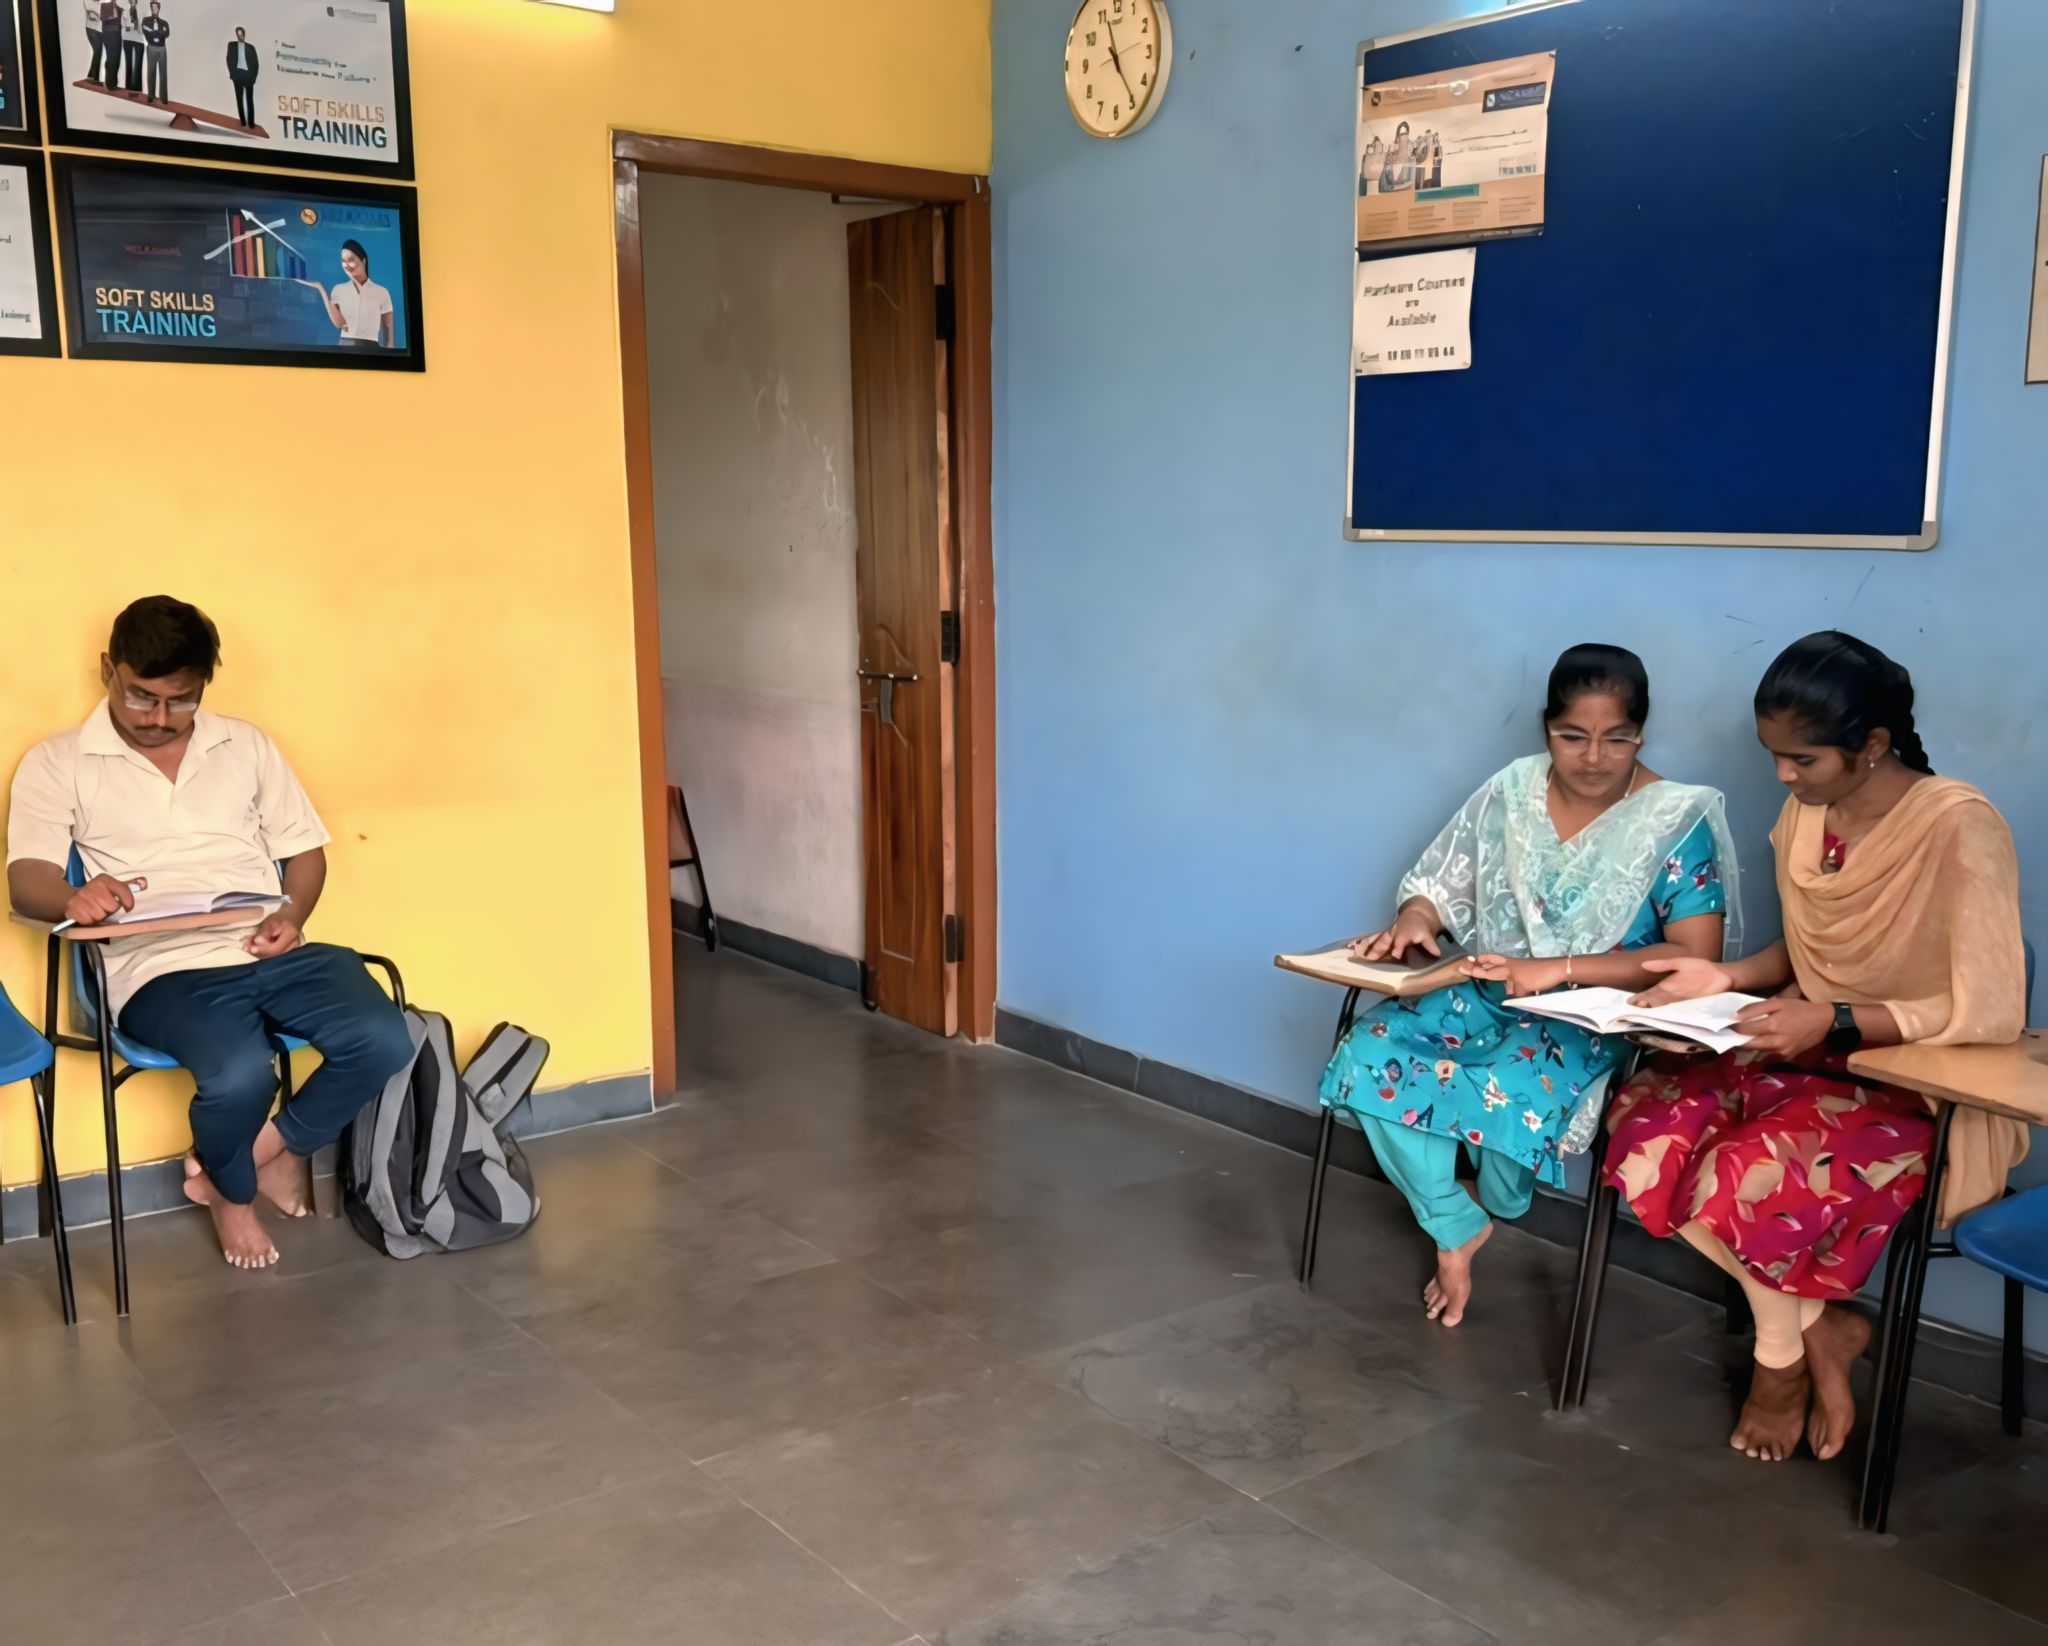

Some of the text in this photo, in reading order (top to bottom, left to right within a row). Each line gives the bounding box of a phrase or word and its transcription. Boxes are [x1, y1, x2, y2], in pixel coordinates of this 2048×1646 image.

[1098, 9, 1107, 24] 11
[1141, 17, 1148, 33] 2
[1086, 31, 1096, 46] 10
[1145, 43, 1152, 59] 3
[1082, 58, 1089, 74] 9
[1140, 72, 1147, 86] 4
[1086, 84, 1092, 99] 8
[278, 95, 384, 123] SOFT SKILLS
[1097, 101, 1104, 121] 7
[1113, 104, 1119, 120] 6
[278, 115, 387, 148] TRAINING
[96, 287, 215, 312] SOFT SKILLS
[96, 308, 217, 337] TRAINING
